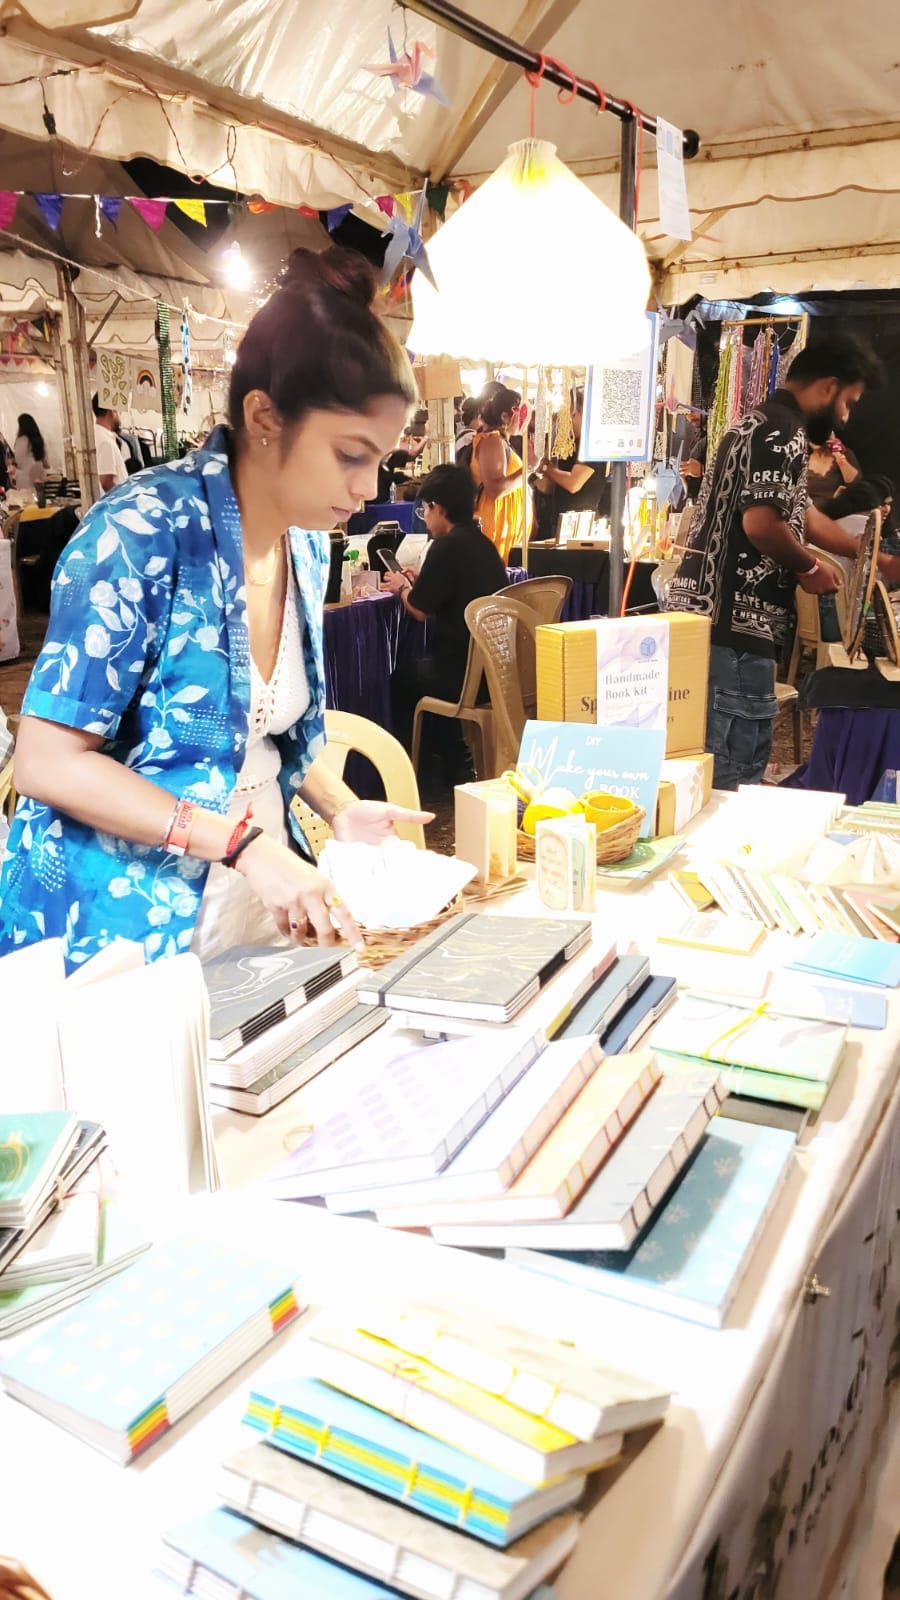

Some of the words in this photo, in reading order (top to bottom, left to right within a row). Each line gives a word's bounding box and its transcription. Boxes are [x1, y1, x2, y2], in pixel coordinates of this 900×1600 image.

[605, 669, 661, 685] Handmade
[605, 687, 631, 700] Book
[634, 686, 648, 697] Kit
[585, 735, 602, 746] DIY
[528, 735, 584, 790] Make
[584, 767, 619, 790] your
[621, 771, 649, 781] own
[600, 783, 640, 799] BOOK
